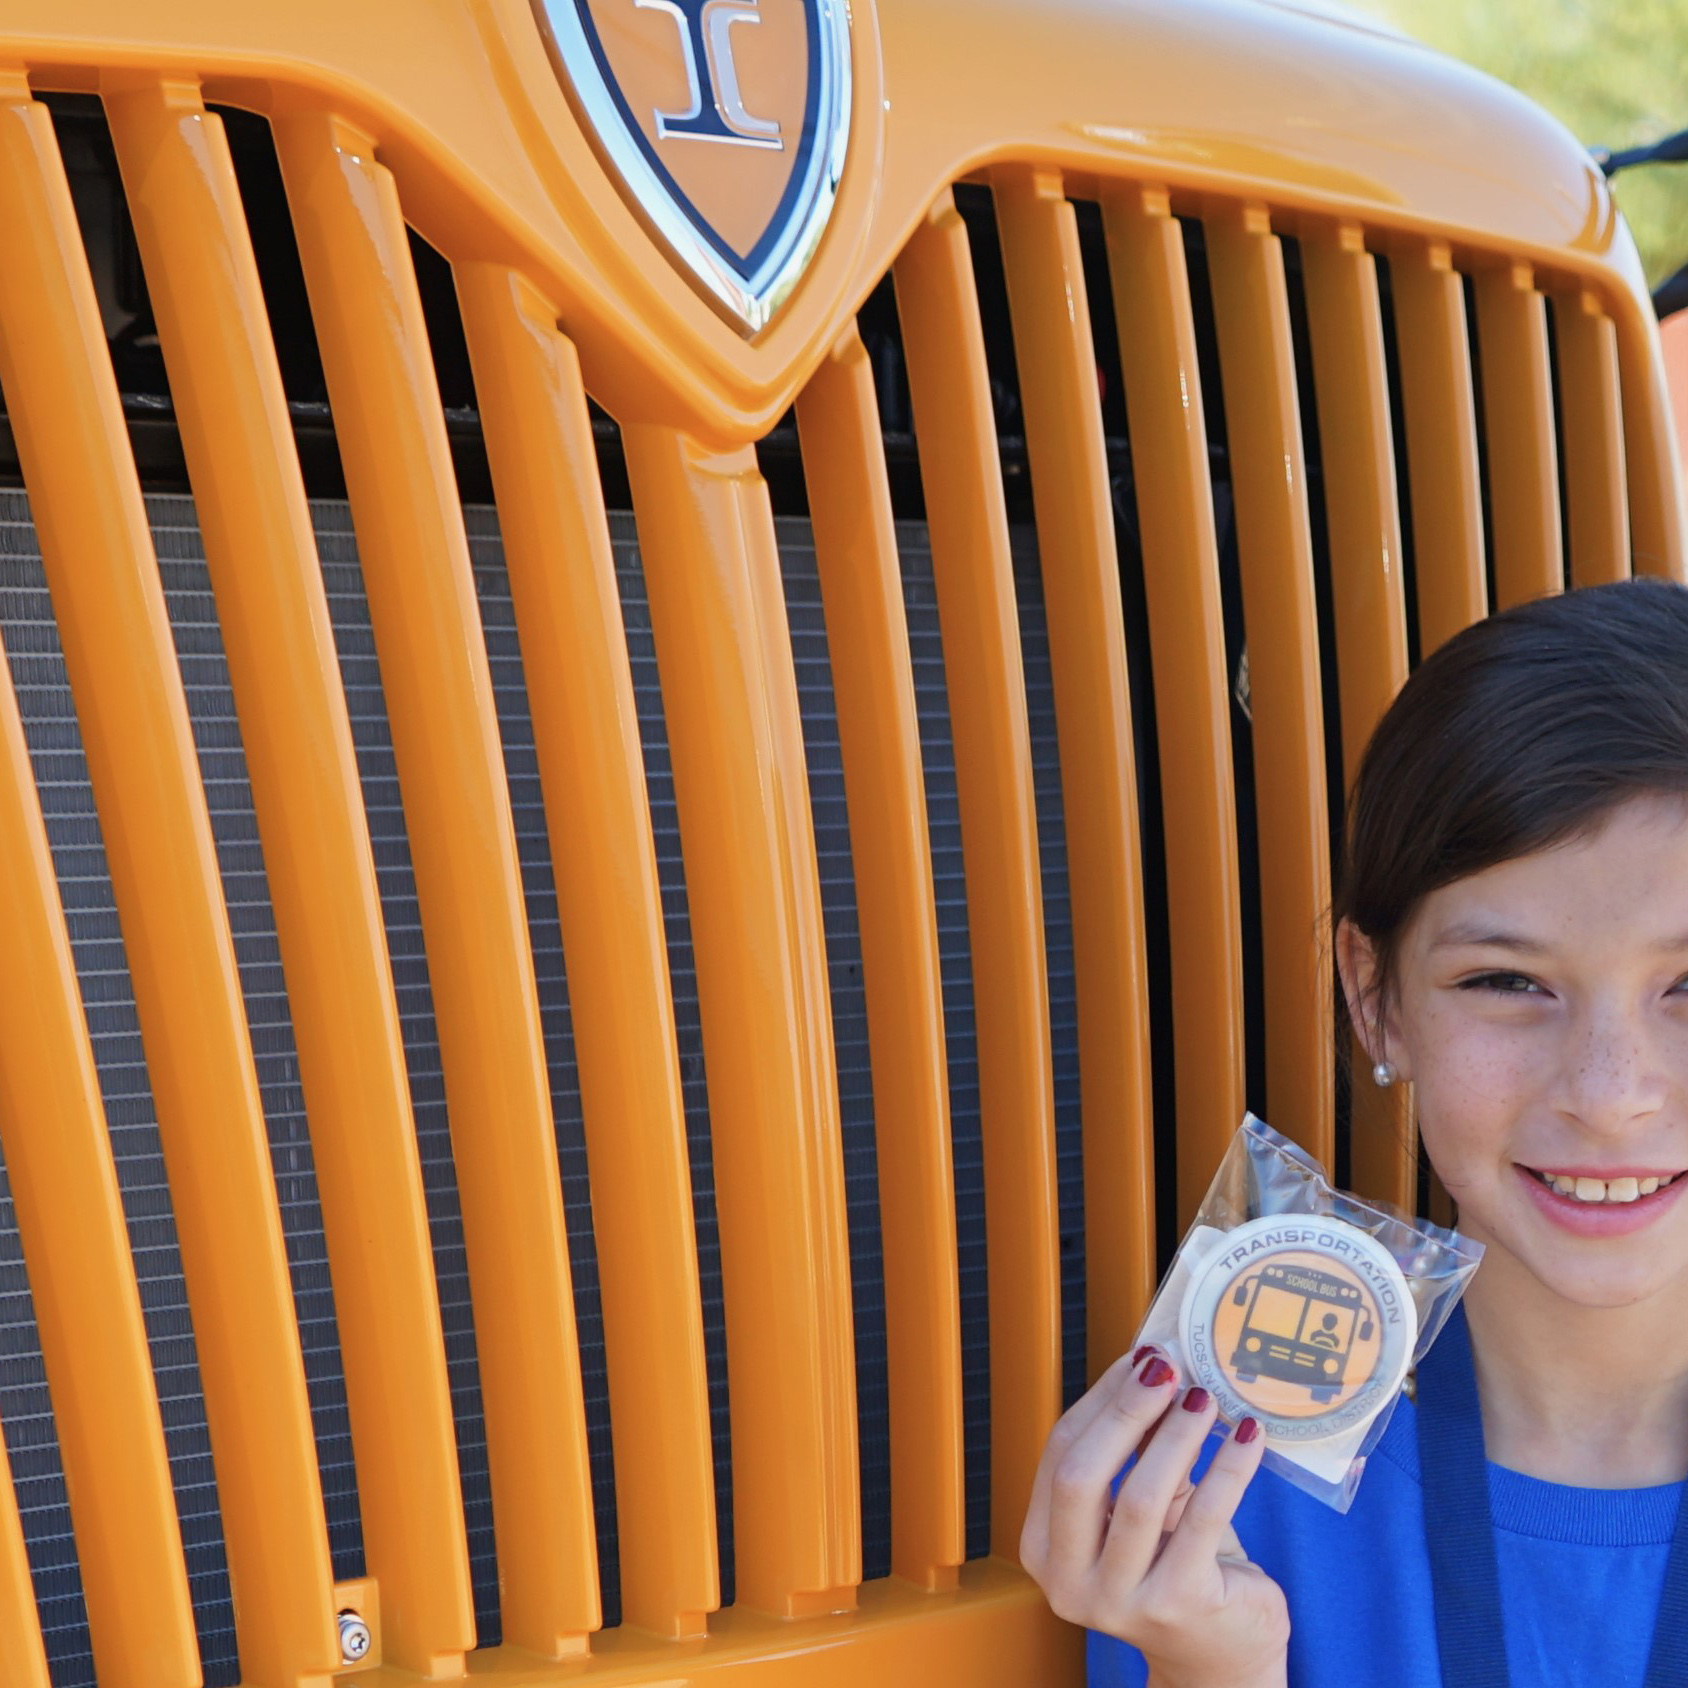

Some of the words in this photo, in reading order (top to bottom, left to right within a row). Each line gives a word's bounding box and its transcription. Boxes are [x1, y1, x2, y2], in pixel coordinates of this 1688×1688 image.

[1219, 1228, 1402, 1326] TRANSPORTATION
[1286, 1273, 1319, 1293] SCHOOL
[1319, 1281, 1338, 1299] BUS
[1192, 1322, 1215, 1387] TUCSON
